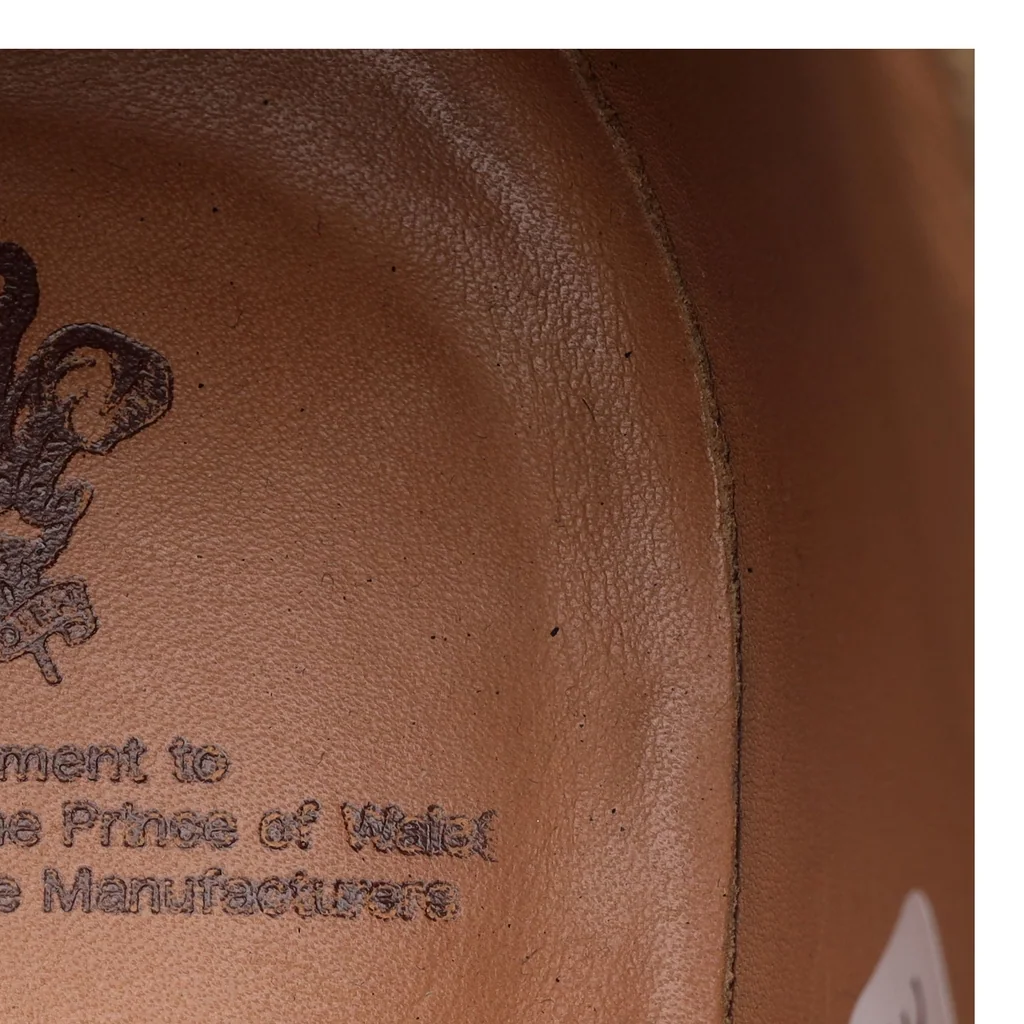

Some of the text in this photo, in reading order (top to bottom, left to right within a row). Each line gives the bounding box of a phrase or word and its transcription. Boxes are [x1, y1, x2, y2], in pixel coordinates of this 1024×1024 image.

[169, 736, 231, 784] to
[61, 800, 239, 849] Prince
[259, 800, 321, 850] of
[42, 866, 462, 922] Manufacturers
